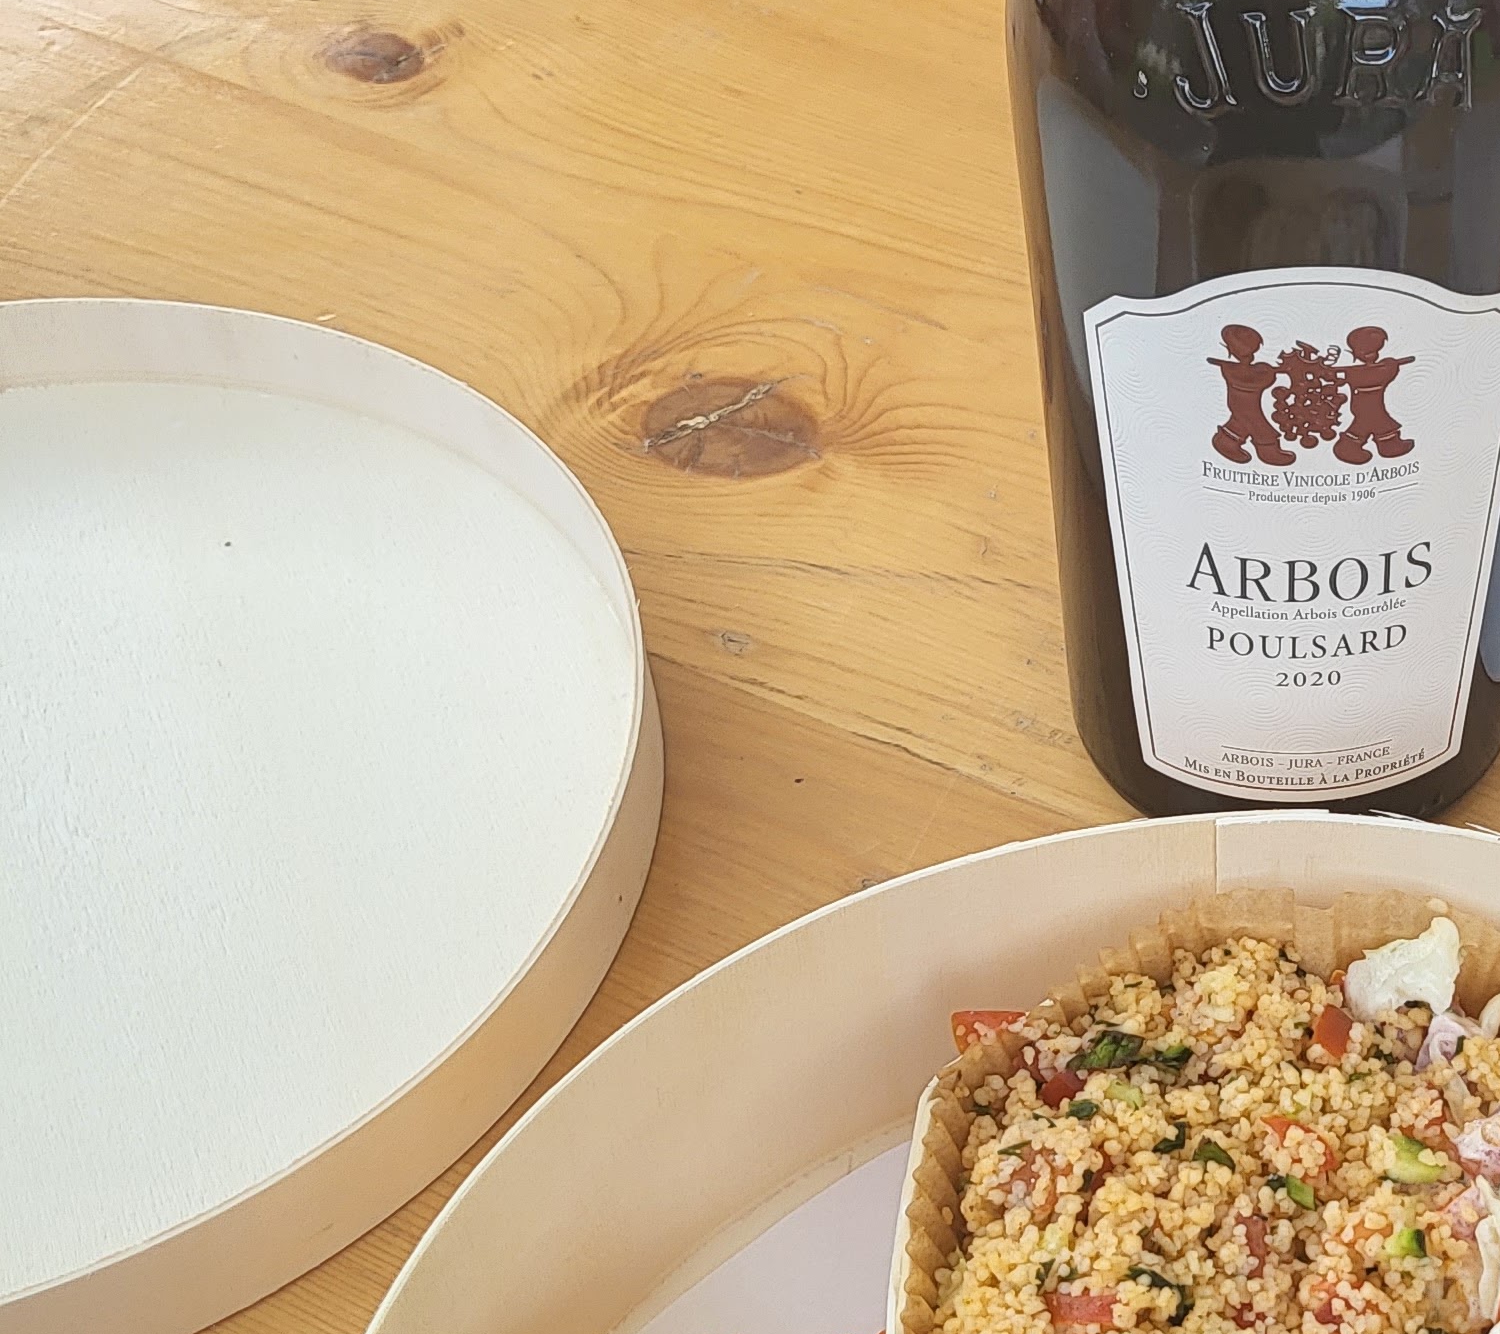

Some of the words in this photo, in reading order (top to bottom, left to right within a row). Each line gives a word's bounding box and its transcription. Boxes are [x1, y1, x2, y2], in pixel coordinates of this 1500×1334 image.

[1173, 1, 1483, 114] JURA
[1202, 460, 1280, 487] FRUITIÈRE
[1282, 471, 1351, 487] VINICOLE
[1355, 461, 1420, 485] D'ARBOIS
[1248, 490, 1309, 504] Producteur
[1311, 492, 1347, 505] depuis
[1351, 487, 1376, 502] 1906
[1186, 541, 1433, 603] ARBOIS
[1210, 601, 1288, 621] Appellation
[1292, 609, 1337, 621] Arbois
[1341, 597, 1407, 618] Contrôlée
[1206, 623, 1407, 659] POULSARD
[1275, 669, 1341, 688] 2020
[1214, 768, 1231, 779] EN
[1236, 769, 1315, 786] BOUTEILLE
[1318, 770, 1329, 785] À
[1333, 773, 1350, 784] LA
[1355, 747, 1426, 780] PROPRIÉTÉ
[1221, 752, 1274, 768] ARBOIS
[1287, 758, 1323, 770] JURA
[1337, 746, 1390, 766] FRANCE
